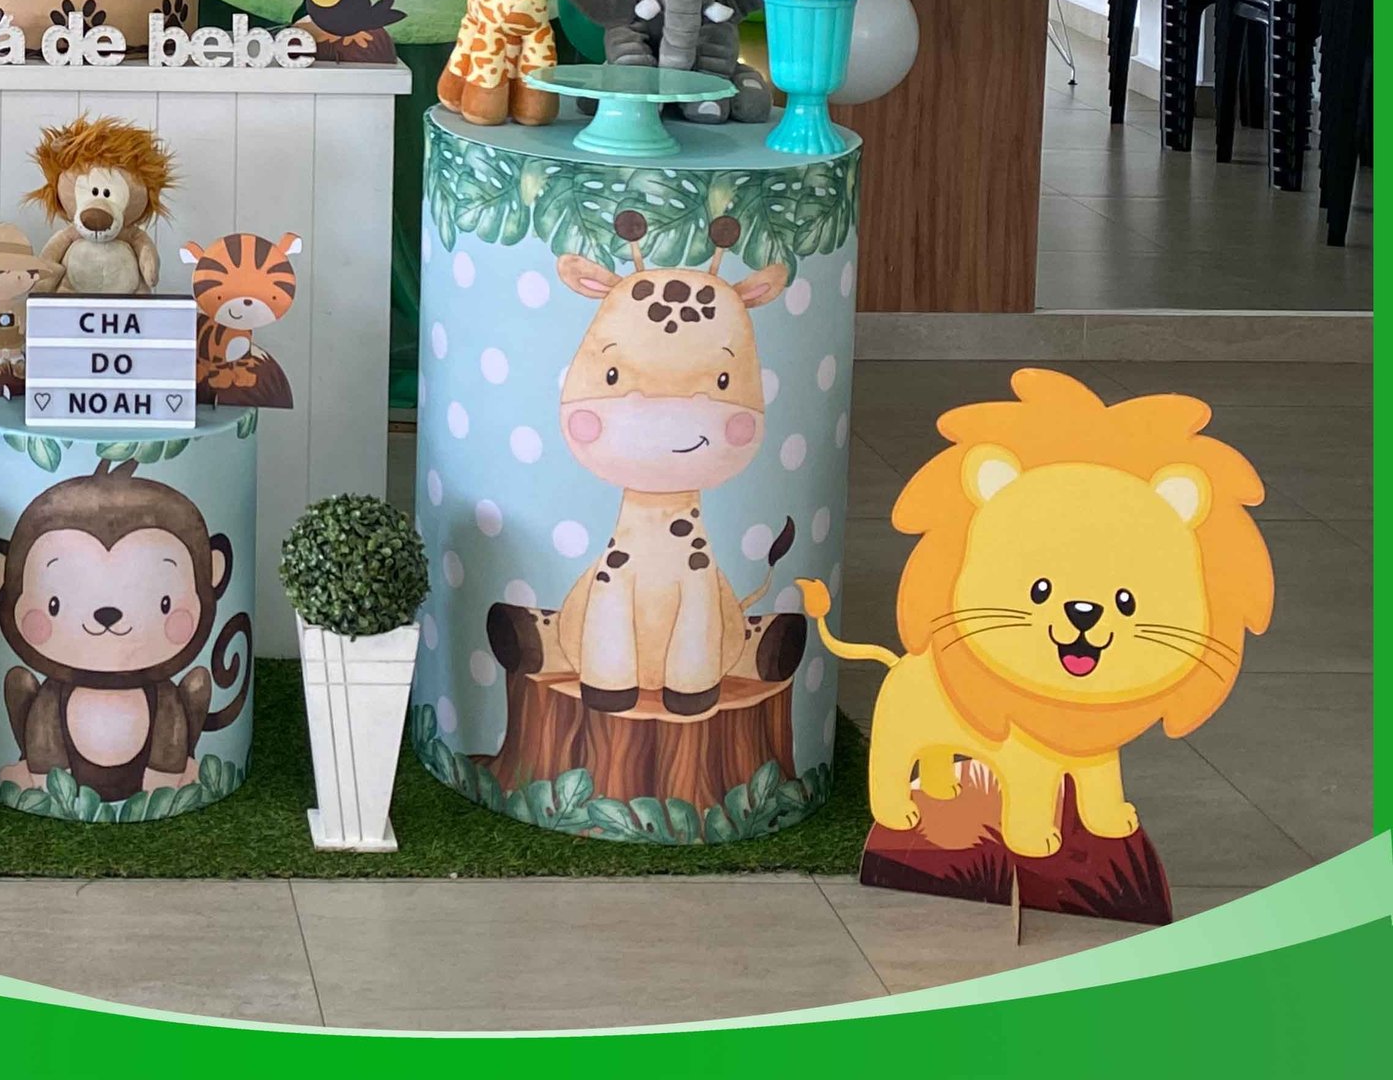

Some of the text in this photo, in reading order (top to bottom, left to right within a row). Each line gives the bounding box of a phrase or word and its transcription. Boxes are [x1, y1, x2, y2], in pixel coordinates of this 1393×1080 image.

[41, 11, 127, 67] de
[148, 13, 317, 68] bebe
[79, 312, 141, 334] CHA
[91, 353, 133, 375] DO
[69, 393, 151, 415] NOAH
